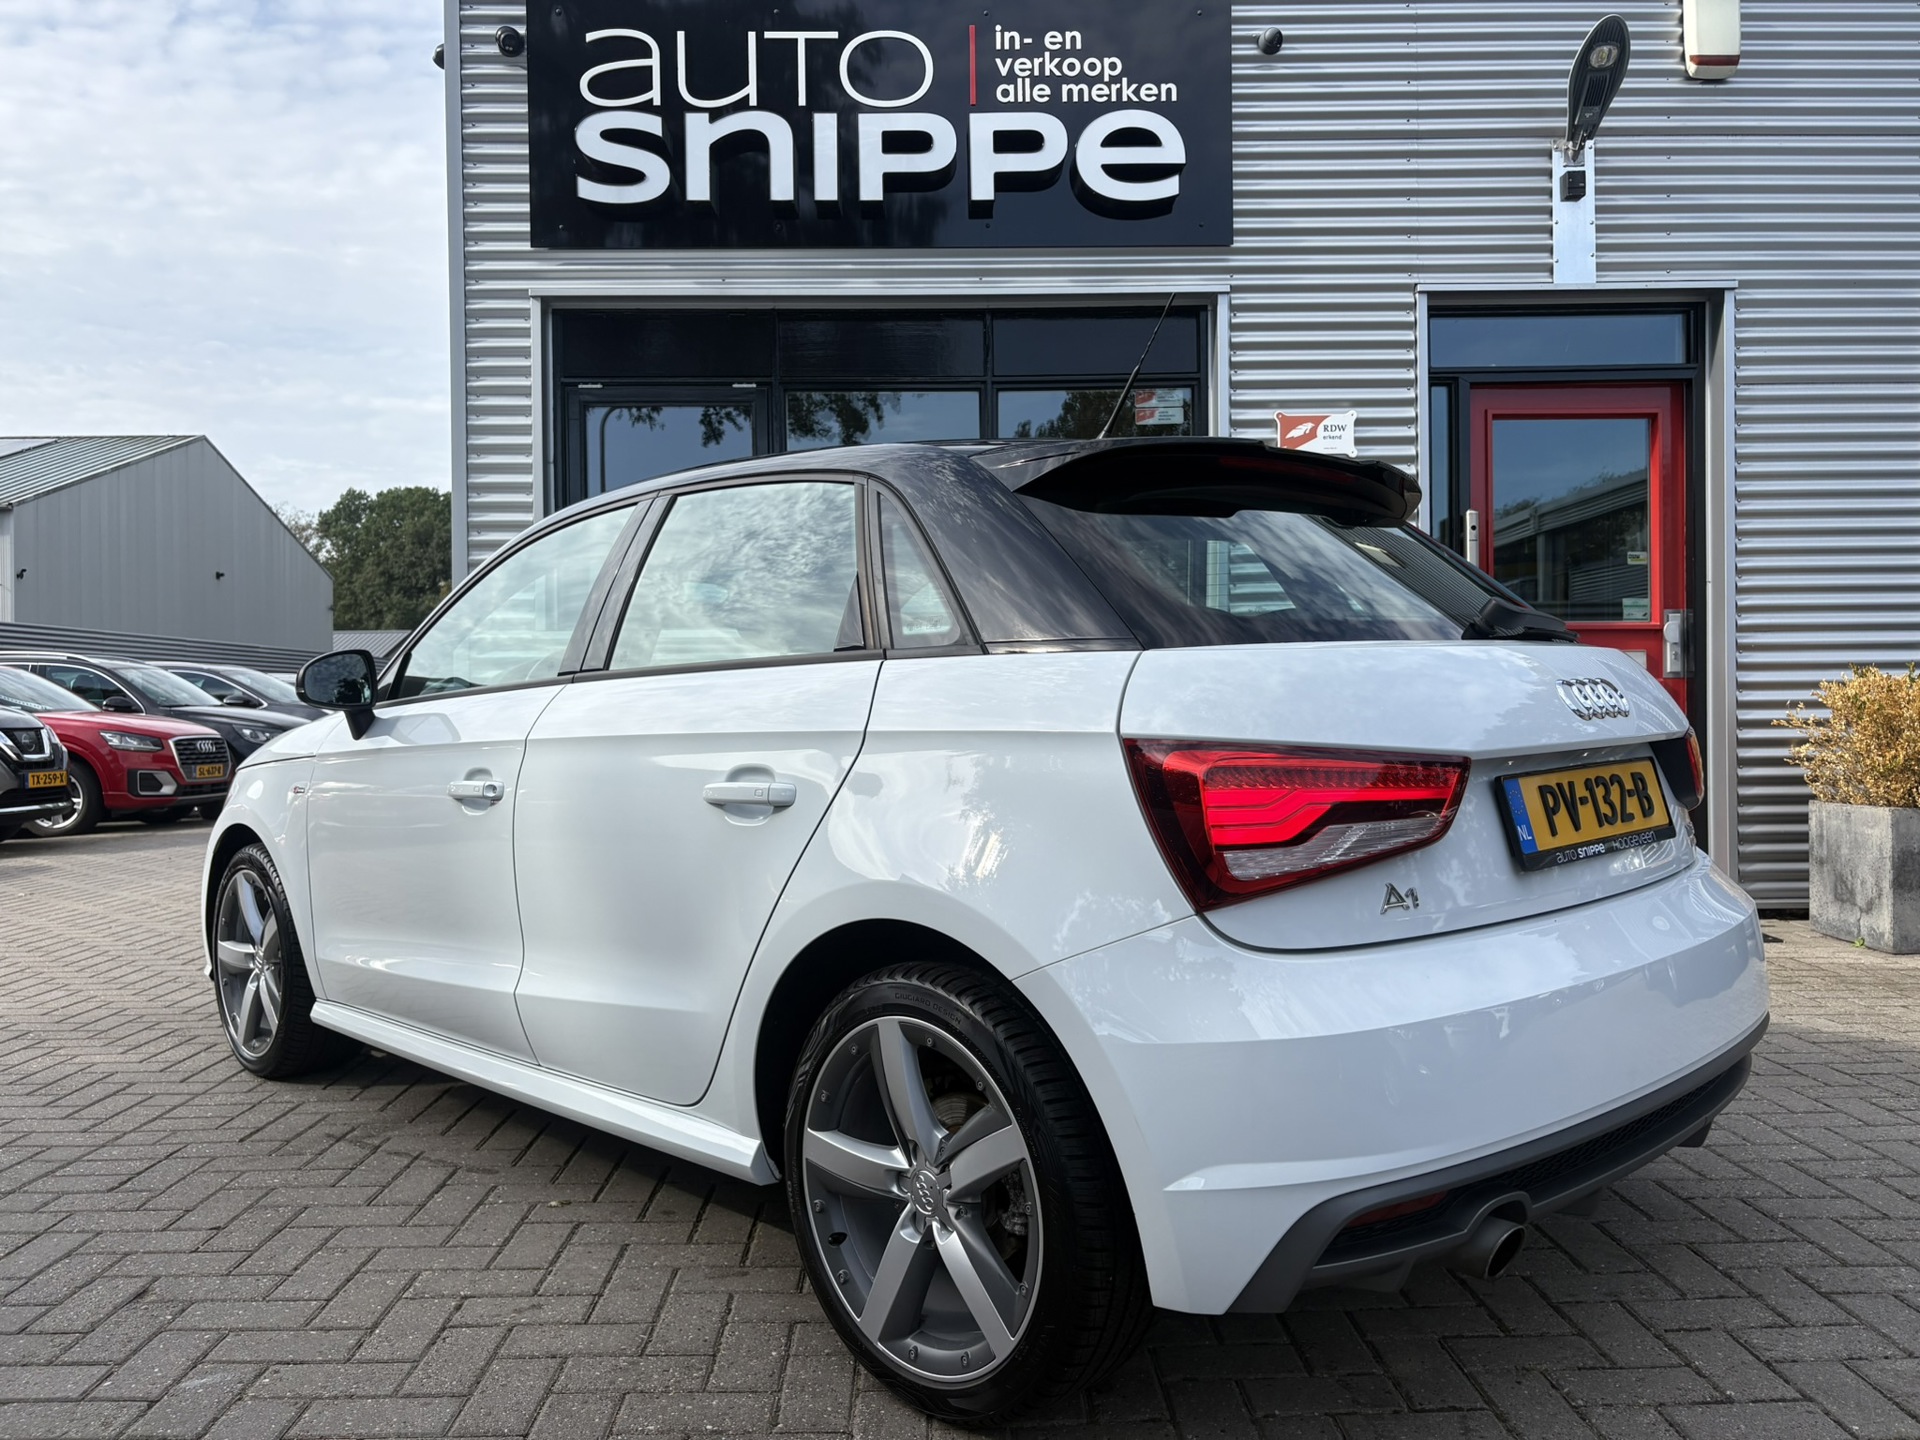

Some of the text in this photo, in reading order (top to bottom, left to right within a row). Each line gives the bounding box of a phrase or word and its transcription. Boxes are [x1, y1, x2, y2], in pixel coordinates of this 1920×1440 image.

[995, 24, 1082, 50] in- en
[994, 51, 1123, 82] verkoop
[996, 77, 1177, 103] alle merken
[1323, 424, 1347, 433] RDW
[30, 772, 65, 786] TX-259-X
[1537, 771, 1655, 838] PV-132-B
[1517, 826, 1533, 841] NL
[1379, 882, 1420, 915] A1
[932, 1003, 962, 1025] DESIGN
